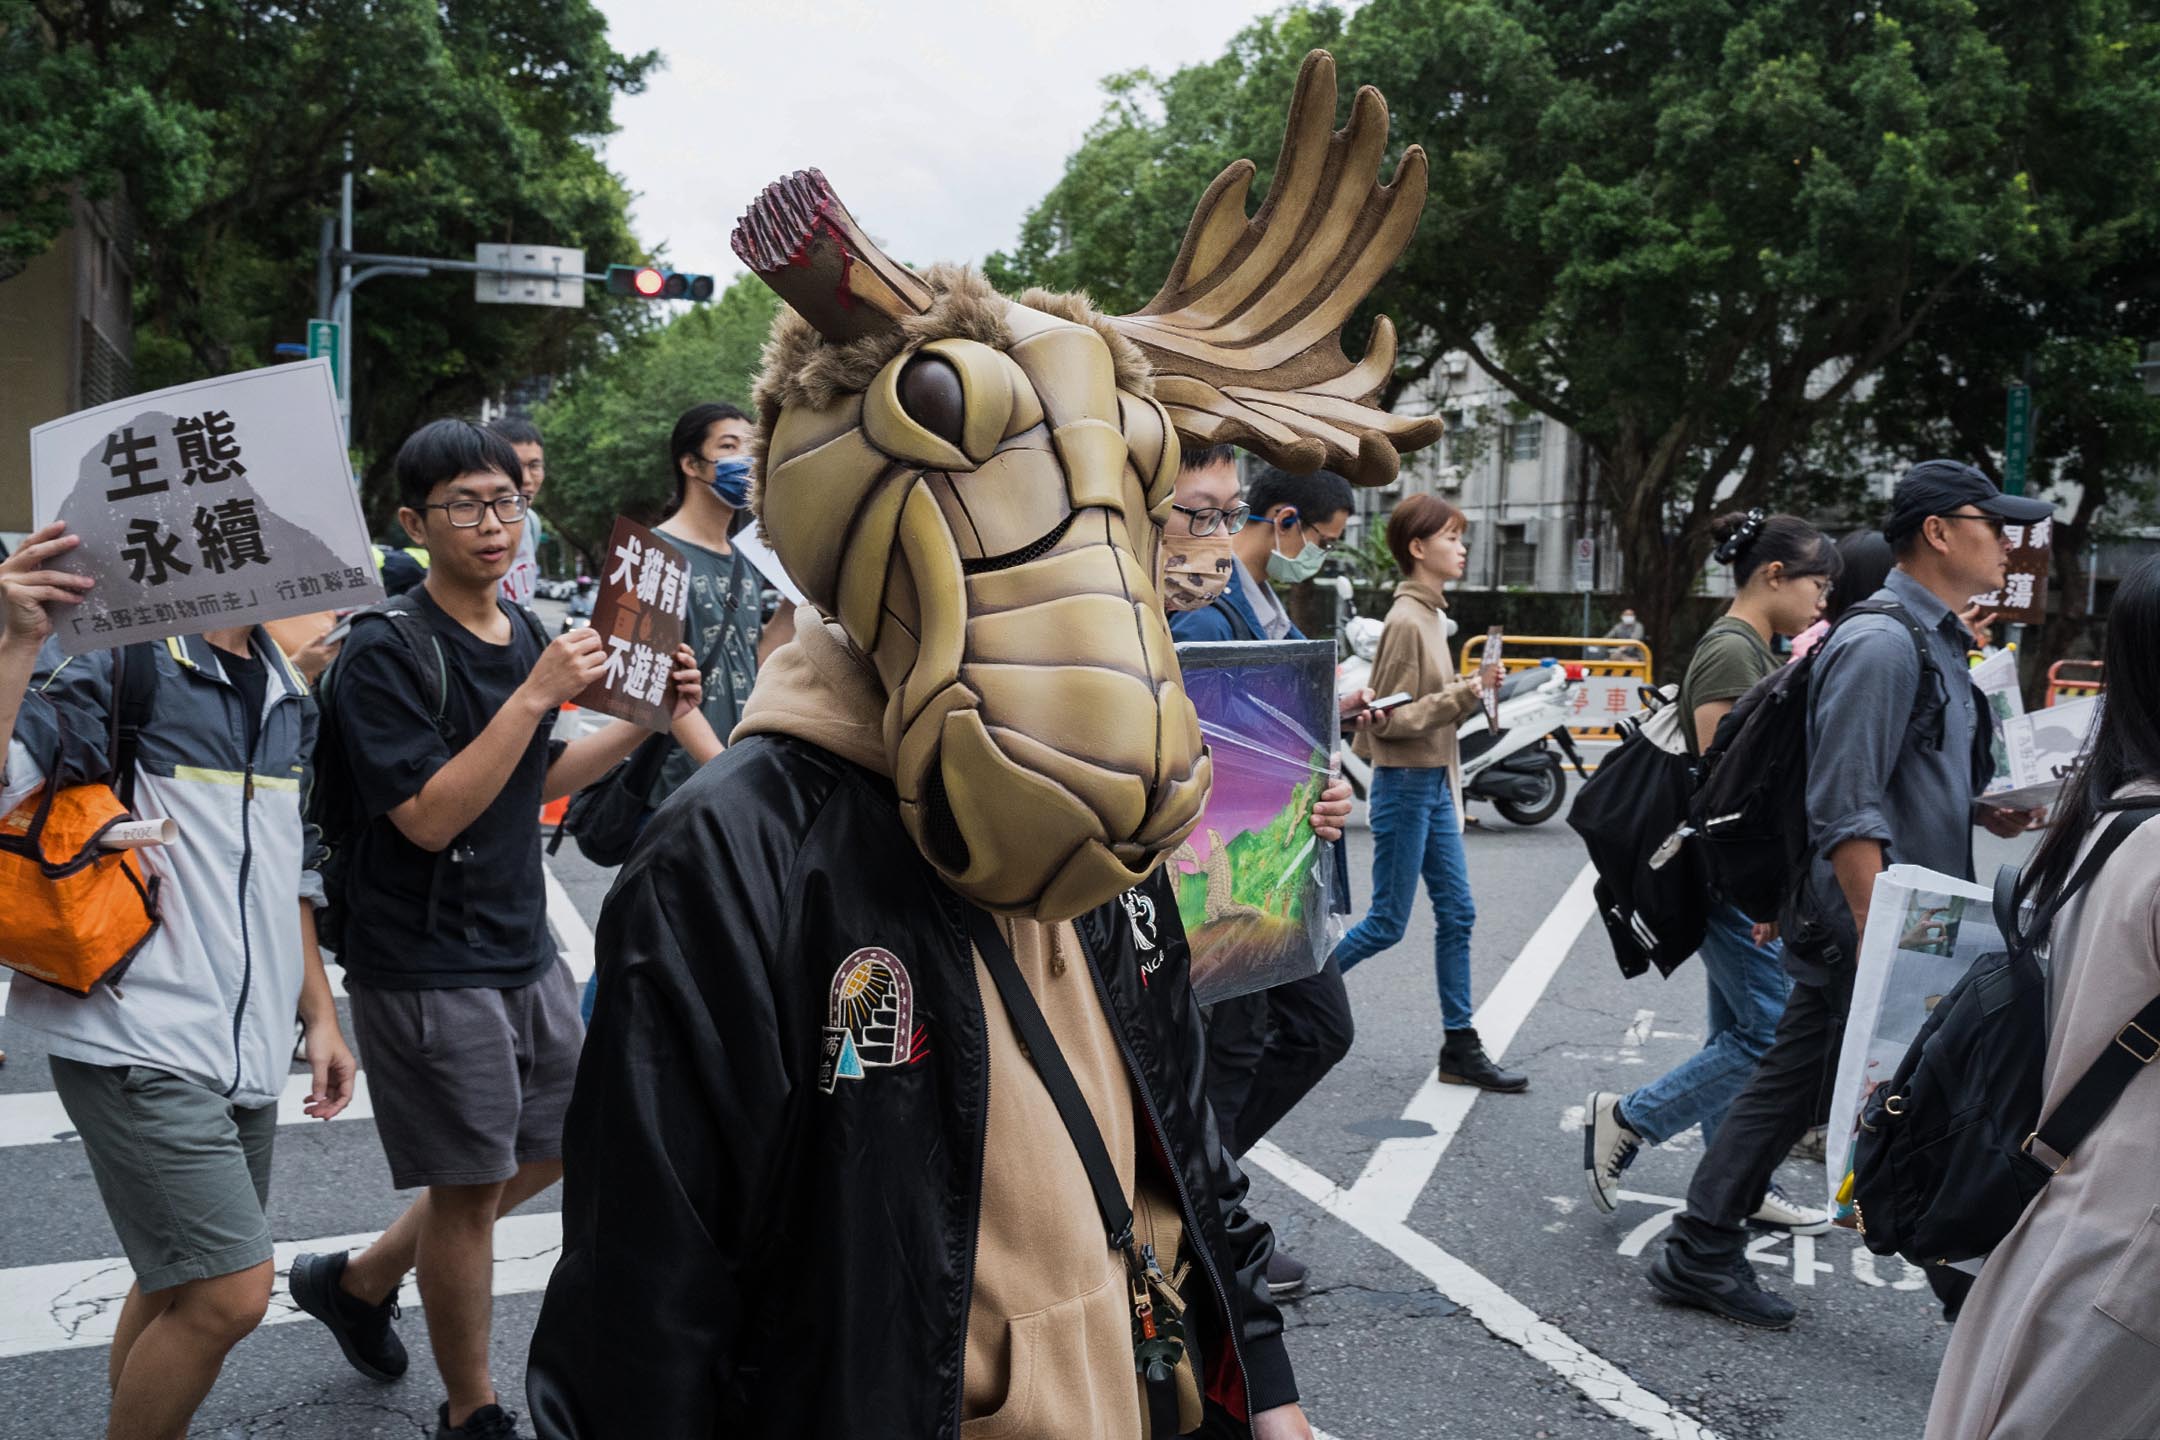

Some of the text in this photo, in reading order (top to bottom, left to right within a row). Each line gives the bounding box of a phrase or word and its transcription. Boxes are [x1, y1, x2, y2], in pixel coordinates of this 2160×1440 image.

[101, 410, 247, 502] 生態
[120, 498, 271, 587] 永續
[276, 566, 367, 600] 行動聯盟
[602, 634, 673, 706] 不遊蕩
